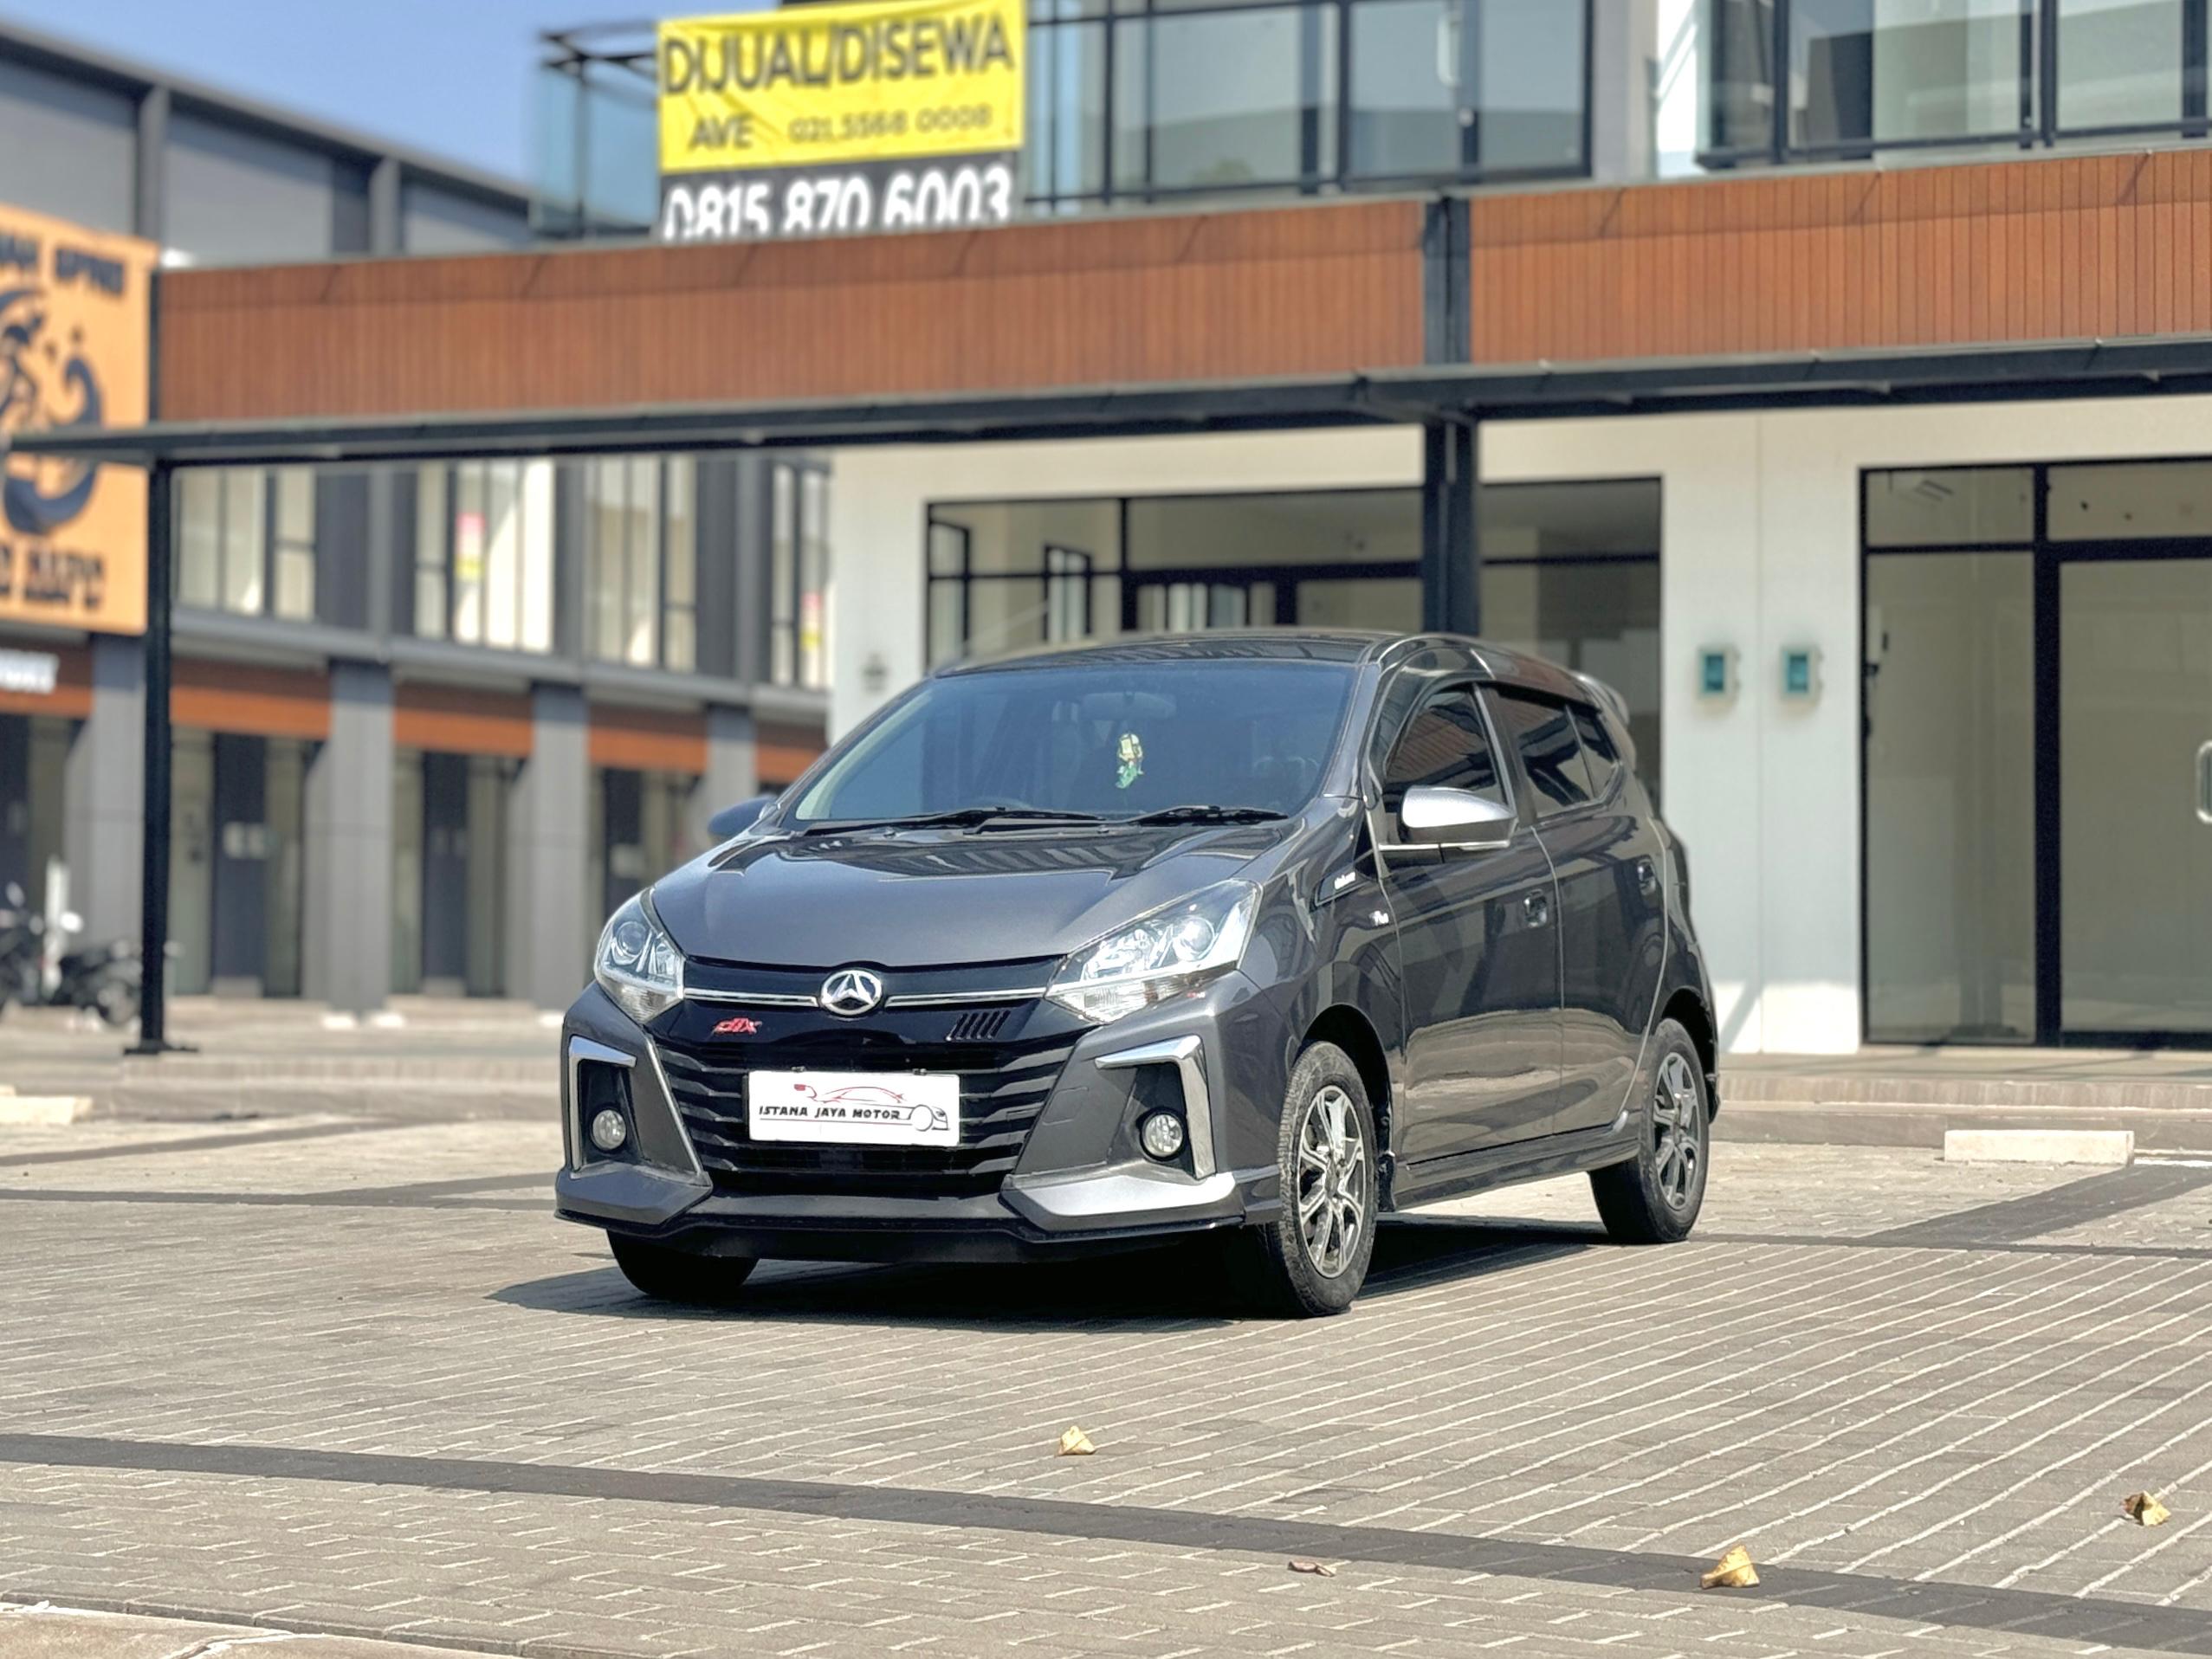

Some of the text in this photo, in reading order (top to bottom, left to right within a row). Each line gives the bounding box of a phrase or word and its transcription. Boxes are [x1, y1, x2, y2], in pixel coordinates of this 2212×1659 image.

[689, 112, 754, 150] AVE
[759, 1106, 900, 1120] ISTANA JAYA MOTOR
